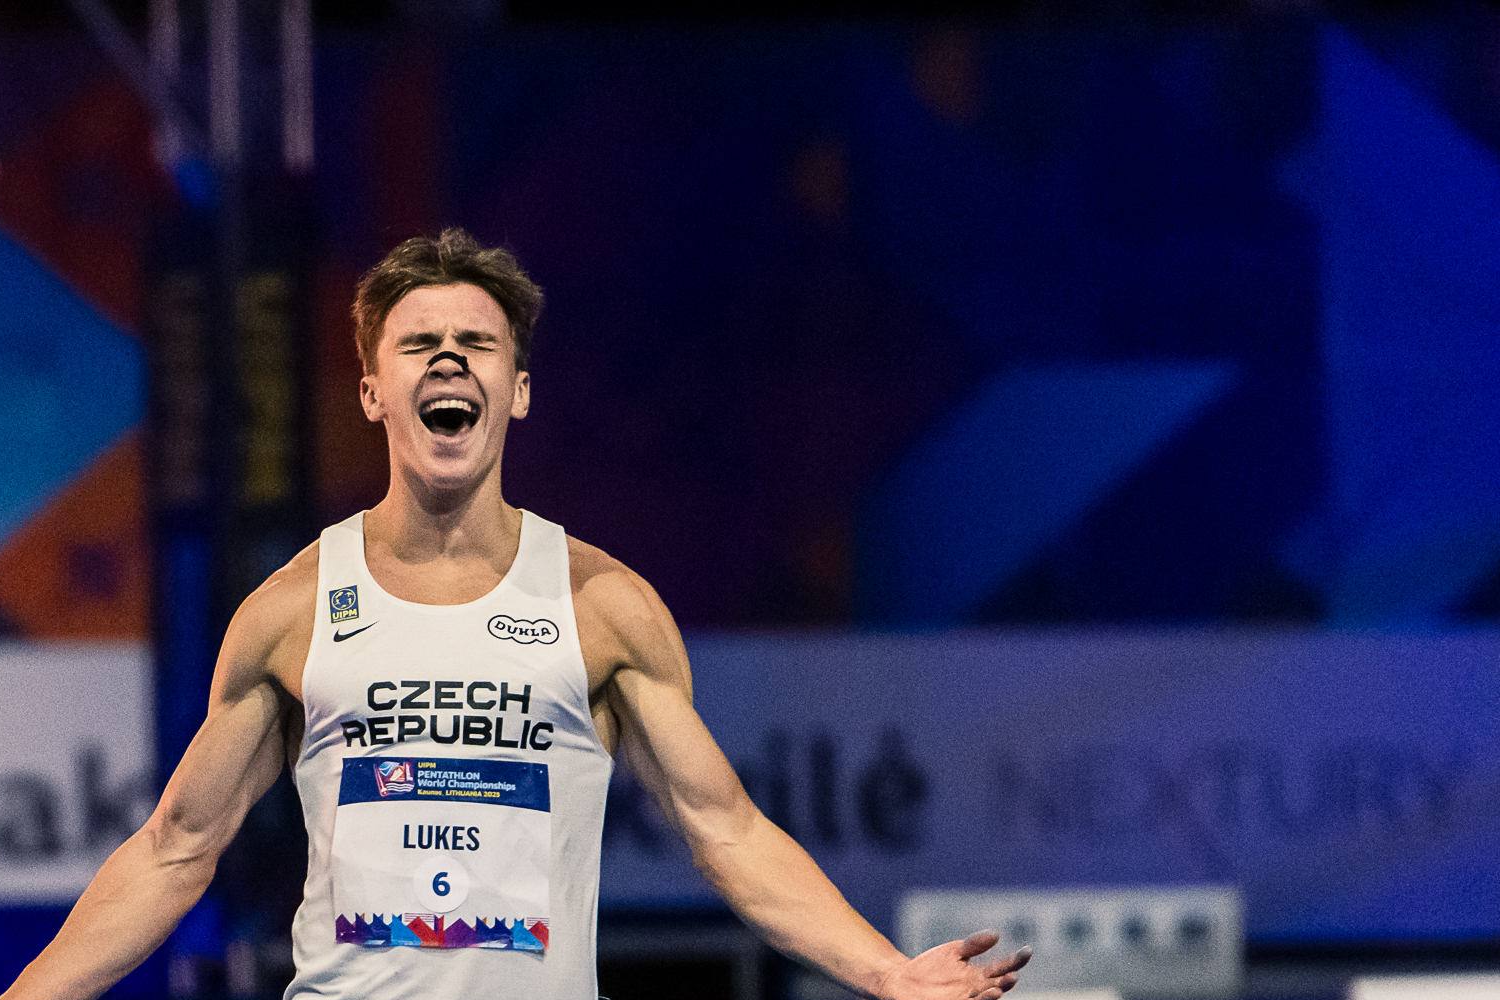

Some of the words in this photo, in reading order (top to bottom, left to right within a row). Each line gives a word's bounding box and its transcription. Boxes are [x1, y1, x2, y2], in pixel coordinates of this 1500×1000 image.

[332, 609, 358, 620] UIPM
[494, 620, 552, 637] DUKLA
[367, 680, 532, 714] CZECH
[340, 714, 554, 751] REPUBLIC
[417, 770, 480, 780] PENTATHLON
[417, 779, 445, 788] World
[447, 780, 516, 791] Championships
[403, 825, 480, 851] LUKES
[432, 872, 451, 897] 6
